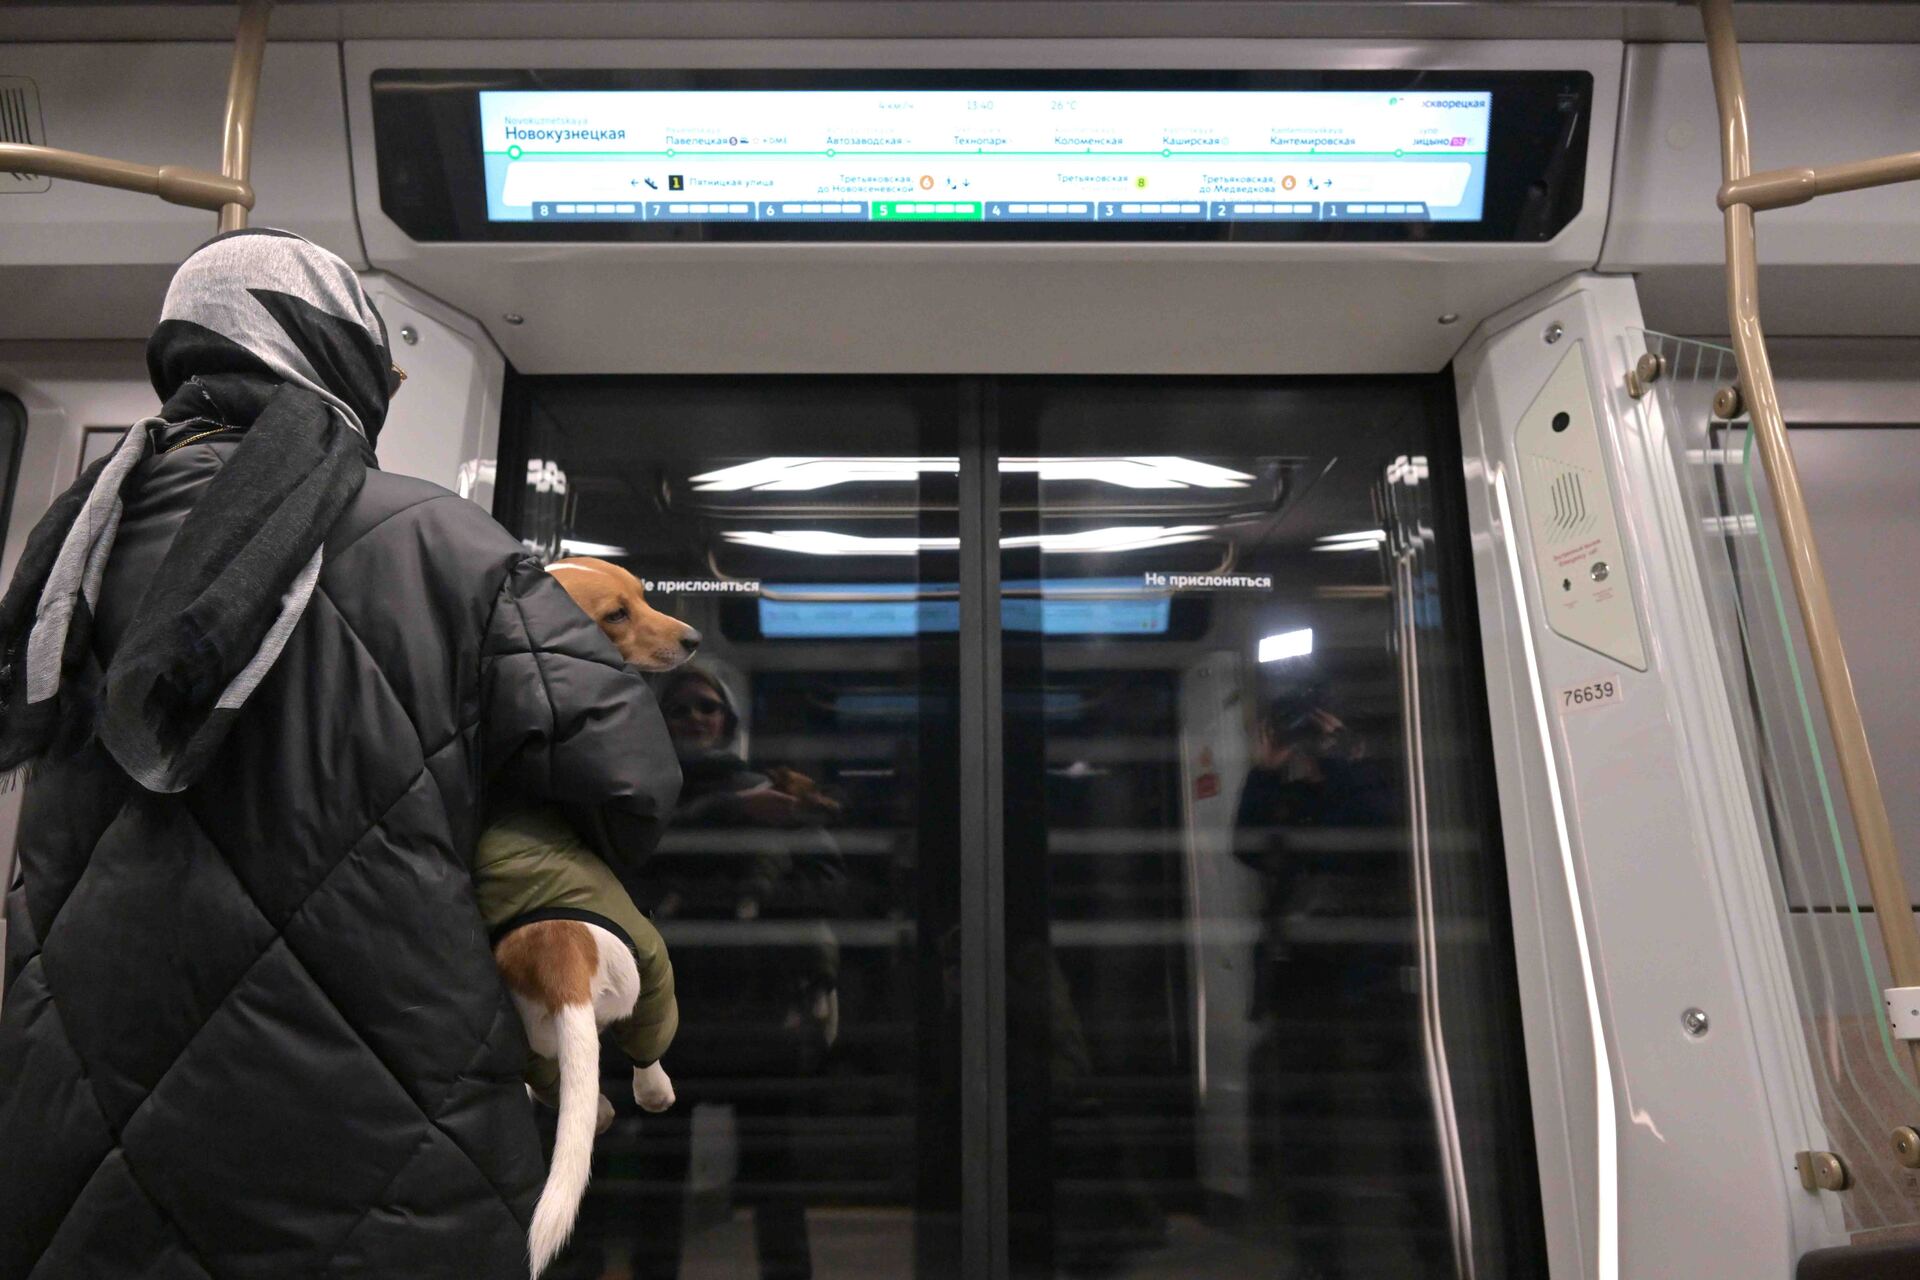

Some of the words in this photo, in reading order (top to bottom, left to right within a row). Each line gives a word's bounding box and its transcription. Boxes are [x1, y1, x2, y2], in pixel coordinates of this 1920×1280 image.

[505, 126, 626, 143] Новокузнецкая
[666, 135, 728, 145] Павелецкая
[954, 135, 1007, 146] Технопарк
[1055, 135, 1123, 145] Коломенская
[1162, 135, 1220, 146] Каширская
[827, 136, 902, 146] Автозаводская
[1270, 135, 1356, 147] Кантемировская
[689, 177, 742, 187] Пятницкая
[745, 179, 774, 188] улица
[1057, 173, 1128, 183] Третьяковская
[1137, 177, 1145, 188] 8
[1199, 186, 1211, 194] до
[540, 205, 549, 216] 8
[652, 204, 661, 216] 7
[766, 204, 775, 216] 6
[879, 204, 888, 216] 5
[992, 204, 1001, 216] 4
[1105, 204, 1114, 216] 3
[1218, 204, 1226, 216] 2
[1330, 204, 1337, 216] 1
[1145, 572, 1165, 585] Не
[1169, 575, 1271, 588] прислоняться
[657, 580, 759, 594] прислоняться
[1563, 682, 1614, 707] 76639
